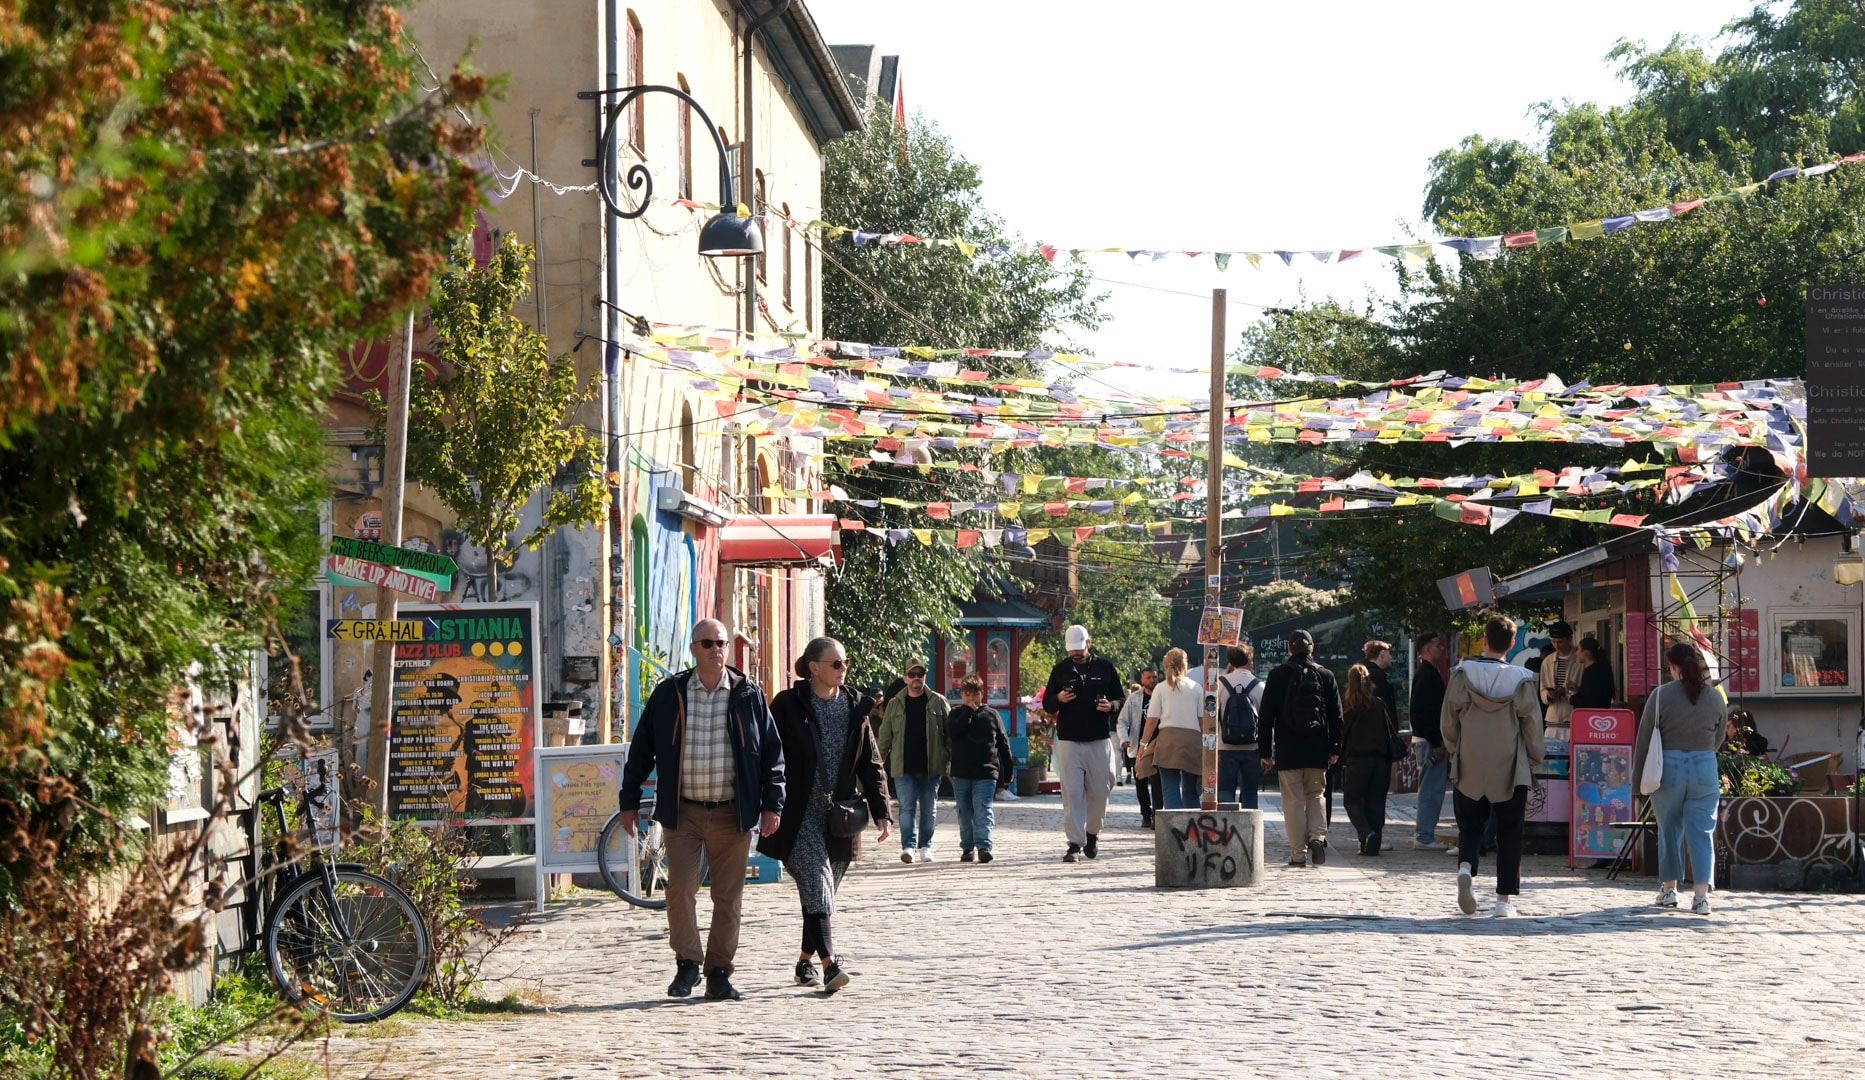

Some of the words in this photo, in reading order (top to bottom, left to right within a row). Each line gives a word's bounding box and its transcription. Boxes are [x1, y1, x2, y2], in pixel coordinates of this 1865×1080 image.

[334, 554, 368, 580] WAKE
[368, 565, 385, 585] UP
[383, 569, 409, 592] AND
[407, 576, 435, 600] LIVE
[352, 621, 388, 640] GRÅ
[390, 621, 420, 640] HAL
[430, 617, 524, 641] ISTIANIA
[426, 643, 462, 658] CLUB
[394, 660, 431, 668] SEPTEMBER
[1588, 732, 1617, 740] FRISKO
